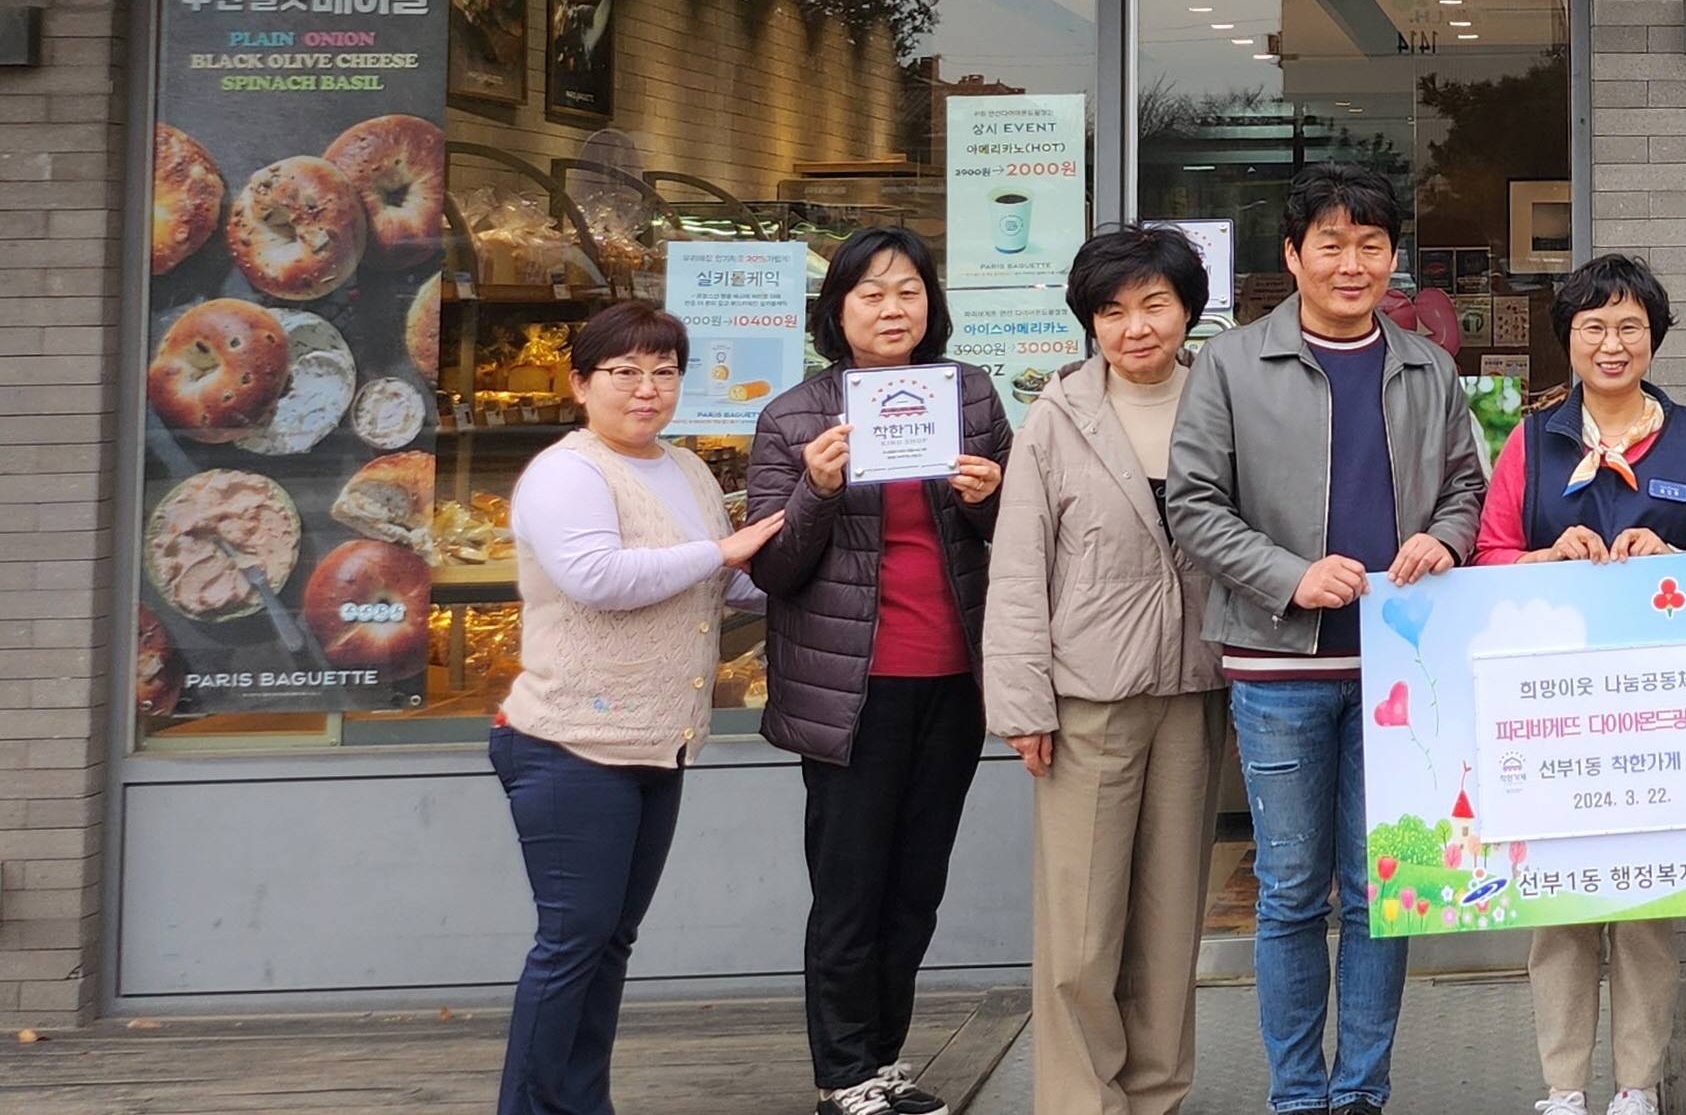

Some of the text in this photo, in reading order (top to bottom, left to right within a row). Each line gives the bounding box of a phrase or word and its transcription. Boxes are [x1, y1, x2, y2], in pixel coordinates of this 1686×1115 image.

[228, 31, 376, 47] PLAIN ONION
[190, 53, 419, 70] BLACK OLIVE CHEESE
[219, 74, 385, 91] SPINACH BASIL
[972, 122, 1058, 136] 상시 EVENT
[966, 142, 1066, 155] 아메리카노(HOT)
[954, 160, 1077, 178] 2900원 2000원
[980, 262, 1052, 270] PARIS BAGUETTE
[696, 269, 781, 288] 실키롤케익
[733, 314, 798, 329] 10400원
[963, 321, 1070, 336] 아이스아메리카노
[953, 339, 1079, 357] 3900원 3000원
[872, 421, 936, 440] 착한가게
[184, 669, 379, 689] PARIS BAGUETTE
[1519, 676, 1594, 700] 희망이웃
[1495, 715, 1582, 741] 파리바게뜨
[1538, 756, 1602, 780] 선부1동
[1611, 751, 1682, 774] 착한가게
[1573, 787, 1672, 810] 2024. 3. 22.
[1518, 867, 1602, 898] 선부1동
